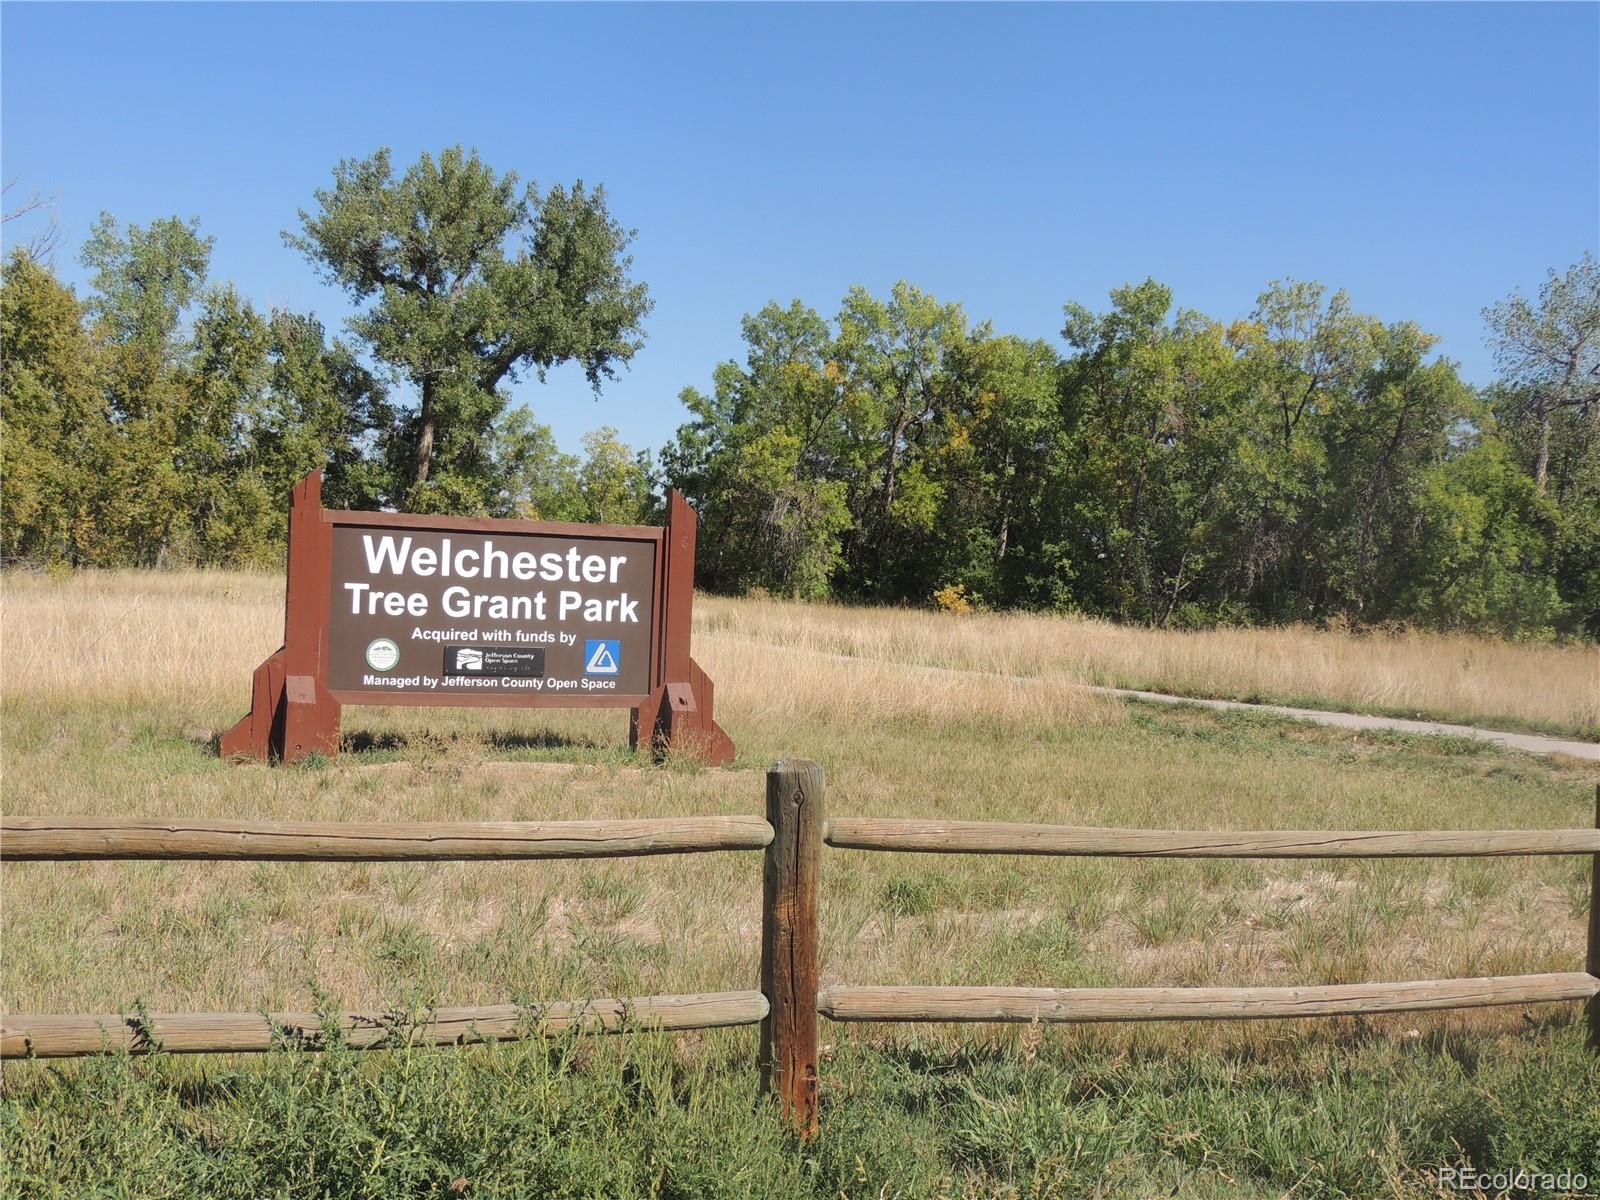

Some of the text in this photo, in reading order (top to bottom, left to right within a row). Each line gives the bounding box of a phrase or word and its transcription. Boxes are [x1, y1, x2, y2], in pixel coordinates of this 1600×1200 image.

[363, 535, 627, 583] Welchester
[344, 582, 639, 622] Tree Grant Park
[411, 627, 576, 646] Acquired with funds by
[363, 674, 616, 691] Managed by Jefferson County Open Space
